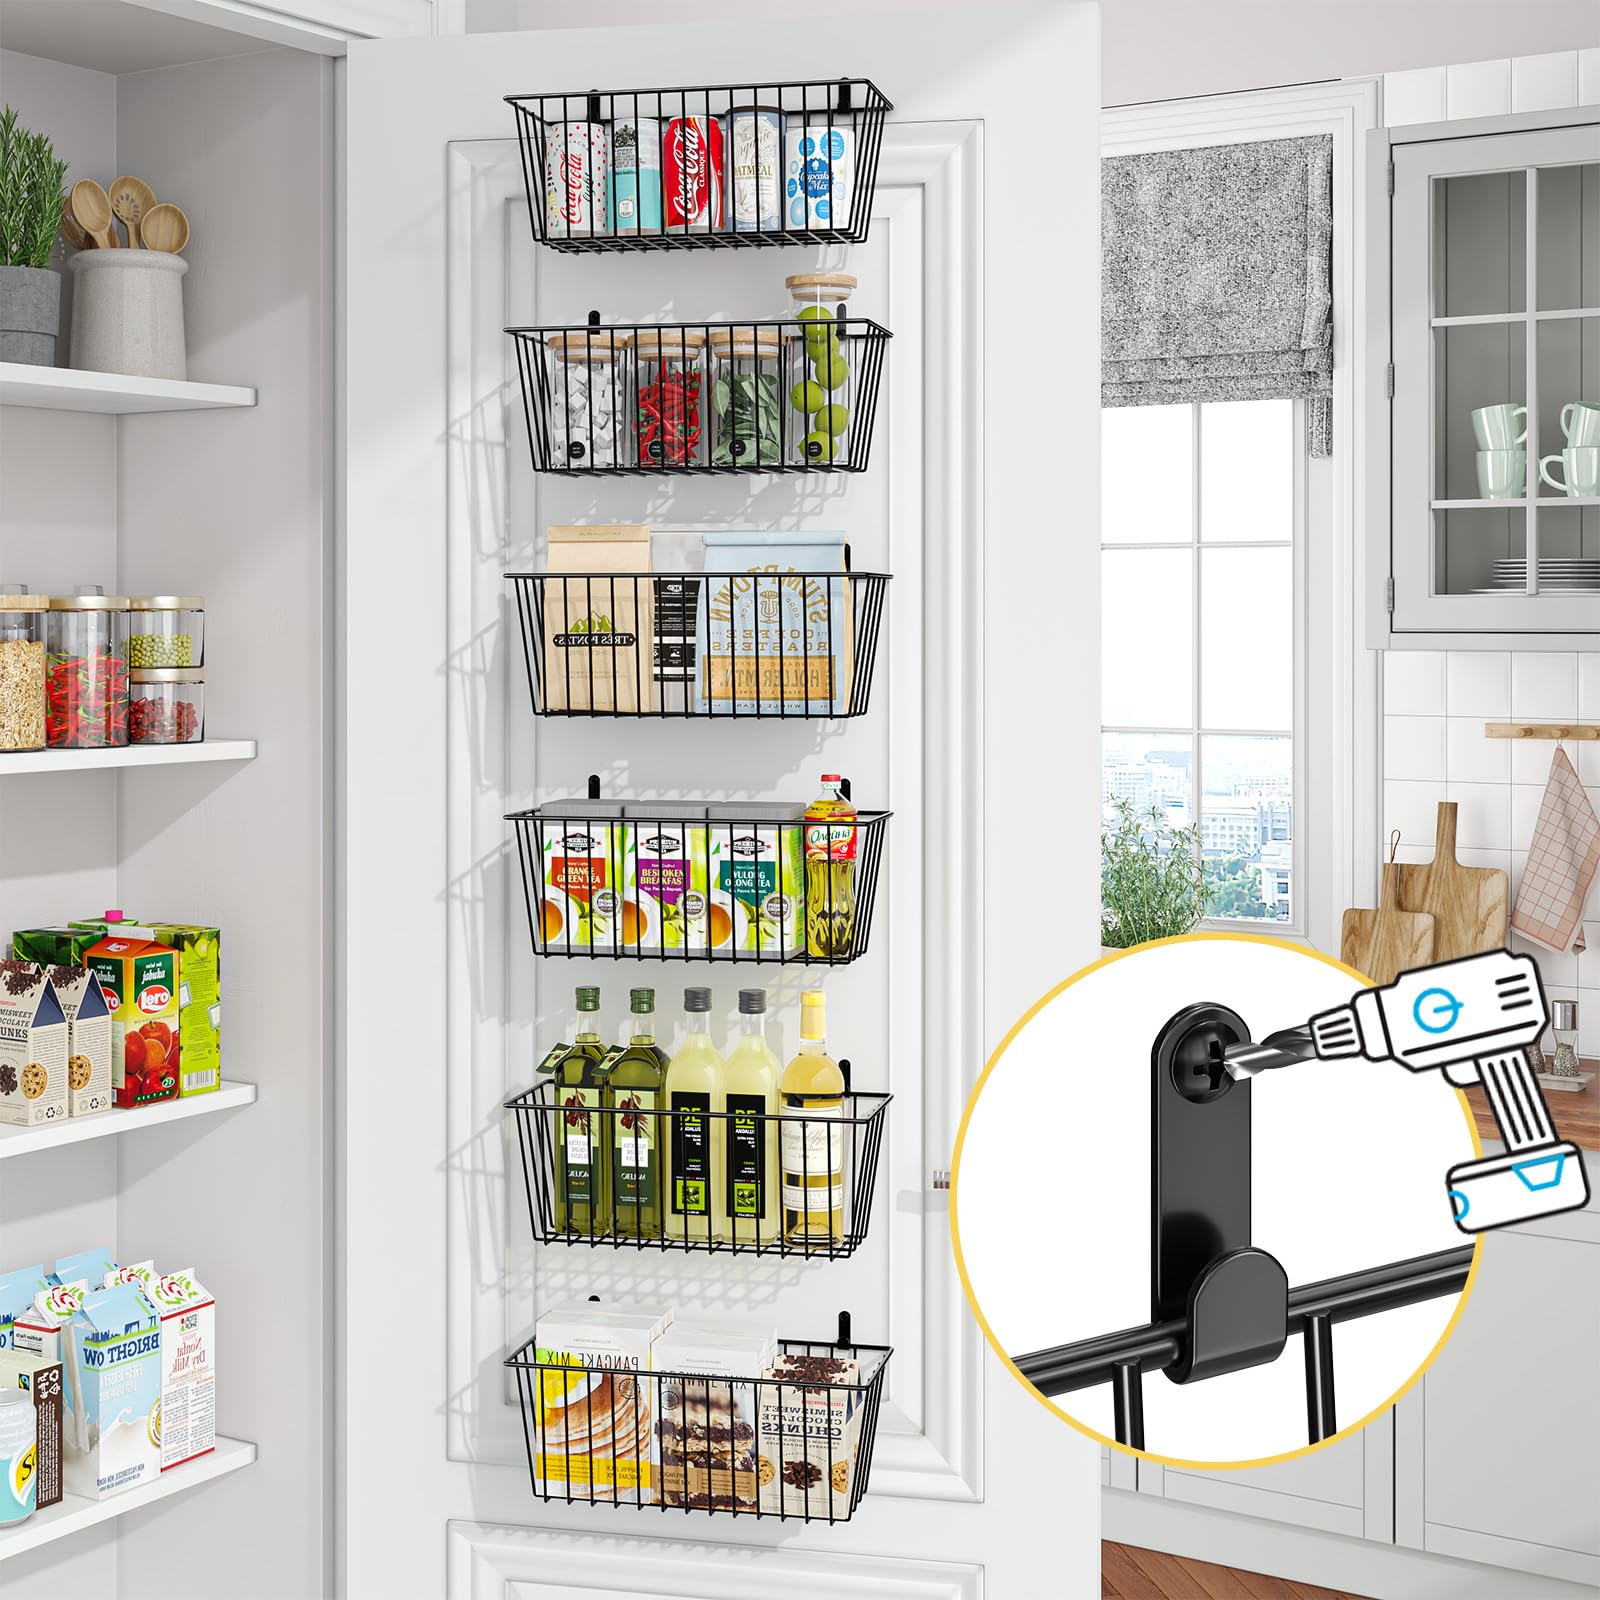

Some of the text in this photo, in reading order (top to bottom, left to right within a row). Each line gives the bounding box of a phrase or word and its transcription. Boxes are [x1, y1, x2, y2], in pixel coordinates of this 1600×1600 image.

[734, 165, 773, 176] ATMEAL
[800, 171, 831, 182] Cupcak
[560, 150, 582, 224] CocaCola
[732, 871, 766, 879] WULOG
[640, 876, 684, 885] BREAKFAS
[725, 878, 753, 887] OONG
